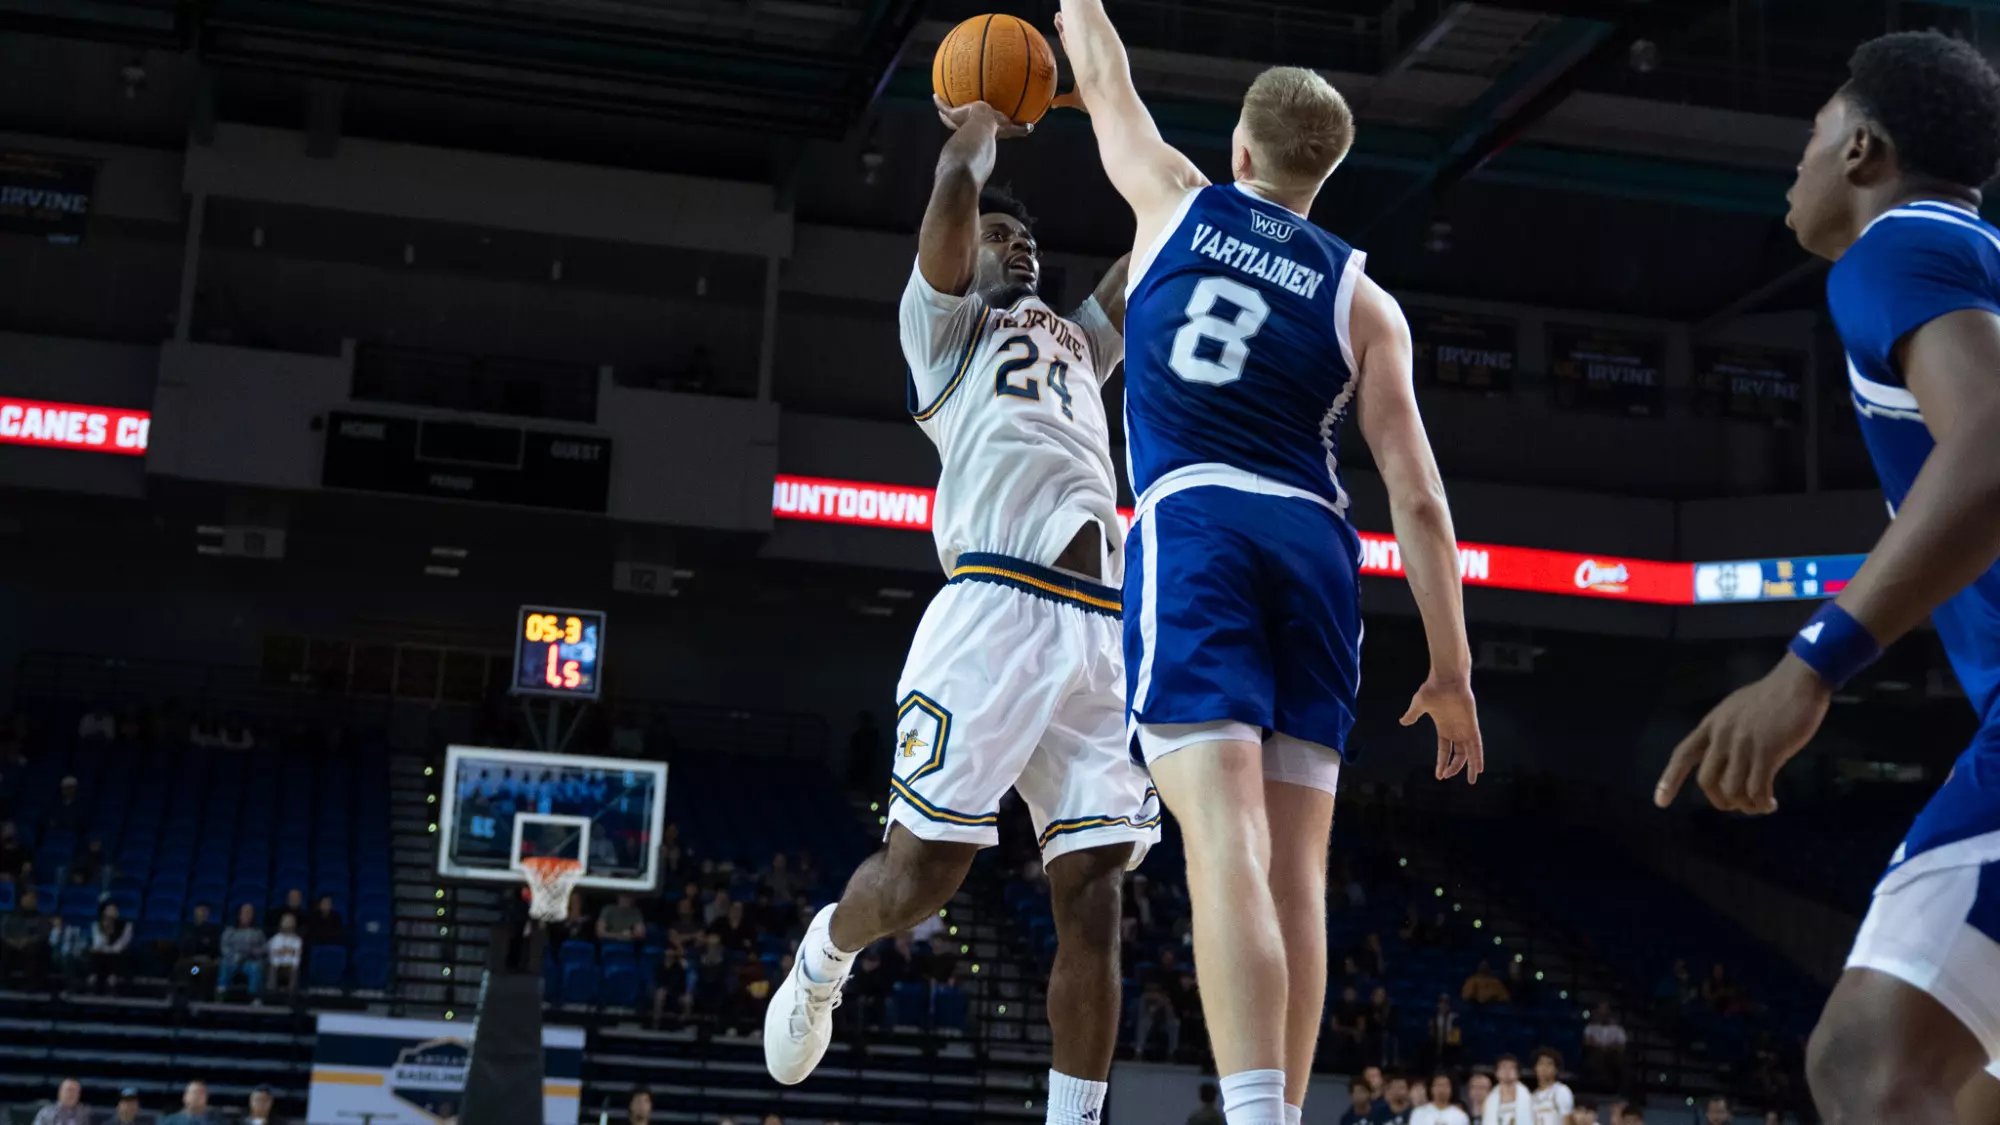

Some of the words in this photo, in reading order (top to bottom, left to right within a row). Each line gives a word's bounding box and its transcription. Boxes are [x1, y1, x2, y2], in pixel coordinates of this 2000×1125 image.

[1255, 214, 1292, 240] WSU
[1190, 223, 1325, 300] VARTIAINEN
[1168, 276, 1271, 387] 8
[994, 334, 1074, 422] 24
[0, 405, 108, 445] CANES
[550, 440, 601, 460] GUEST
[773, 481, 928, 525] UNTDOWN
[525, 613, 583, 644] 05.3
